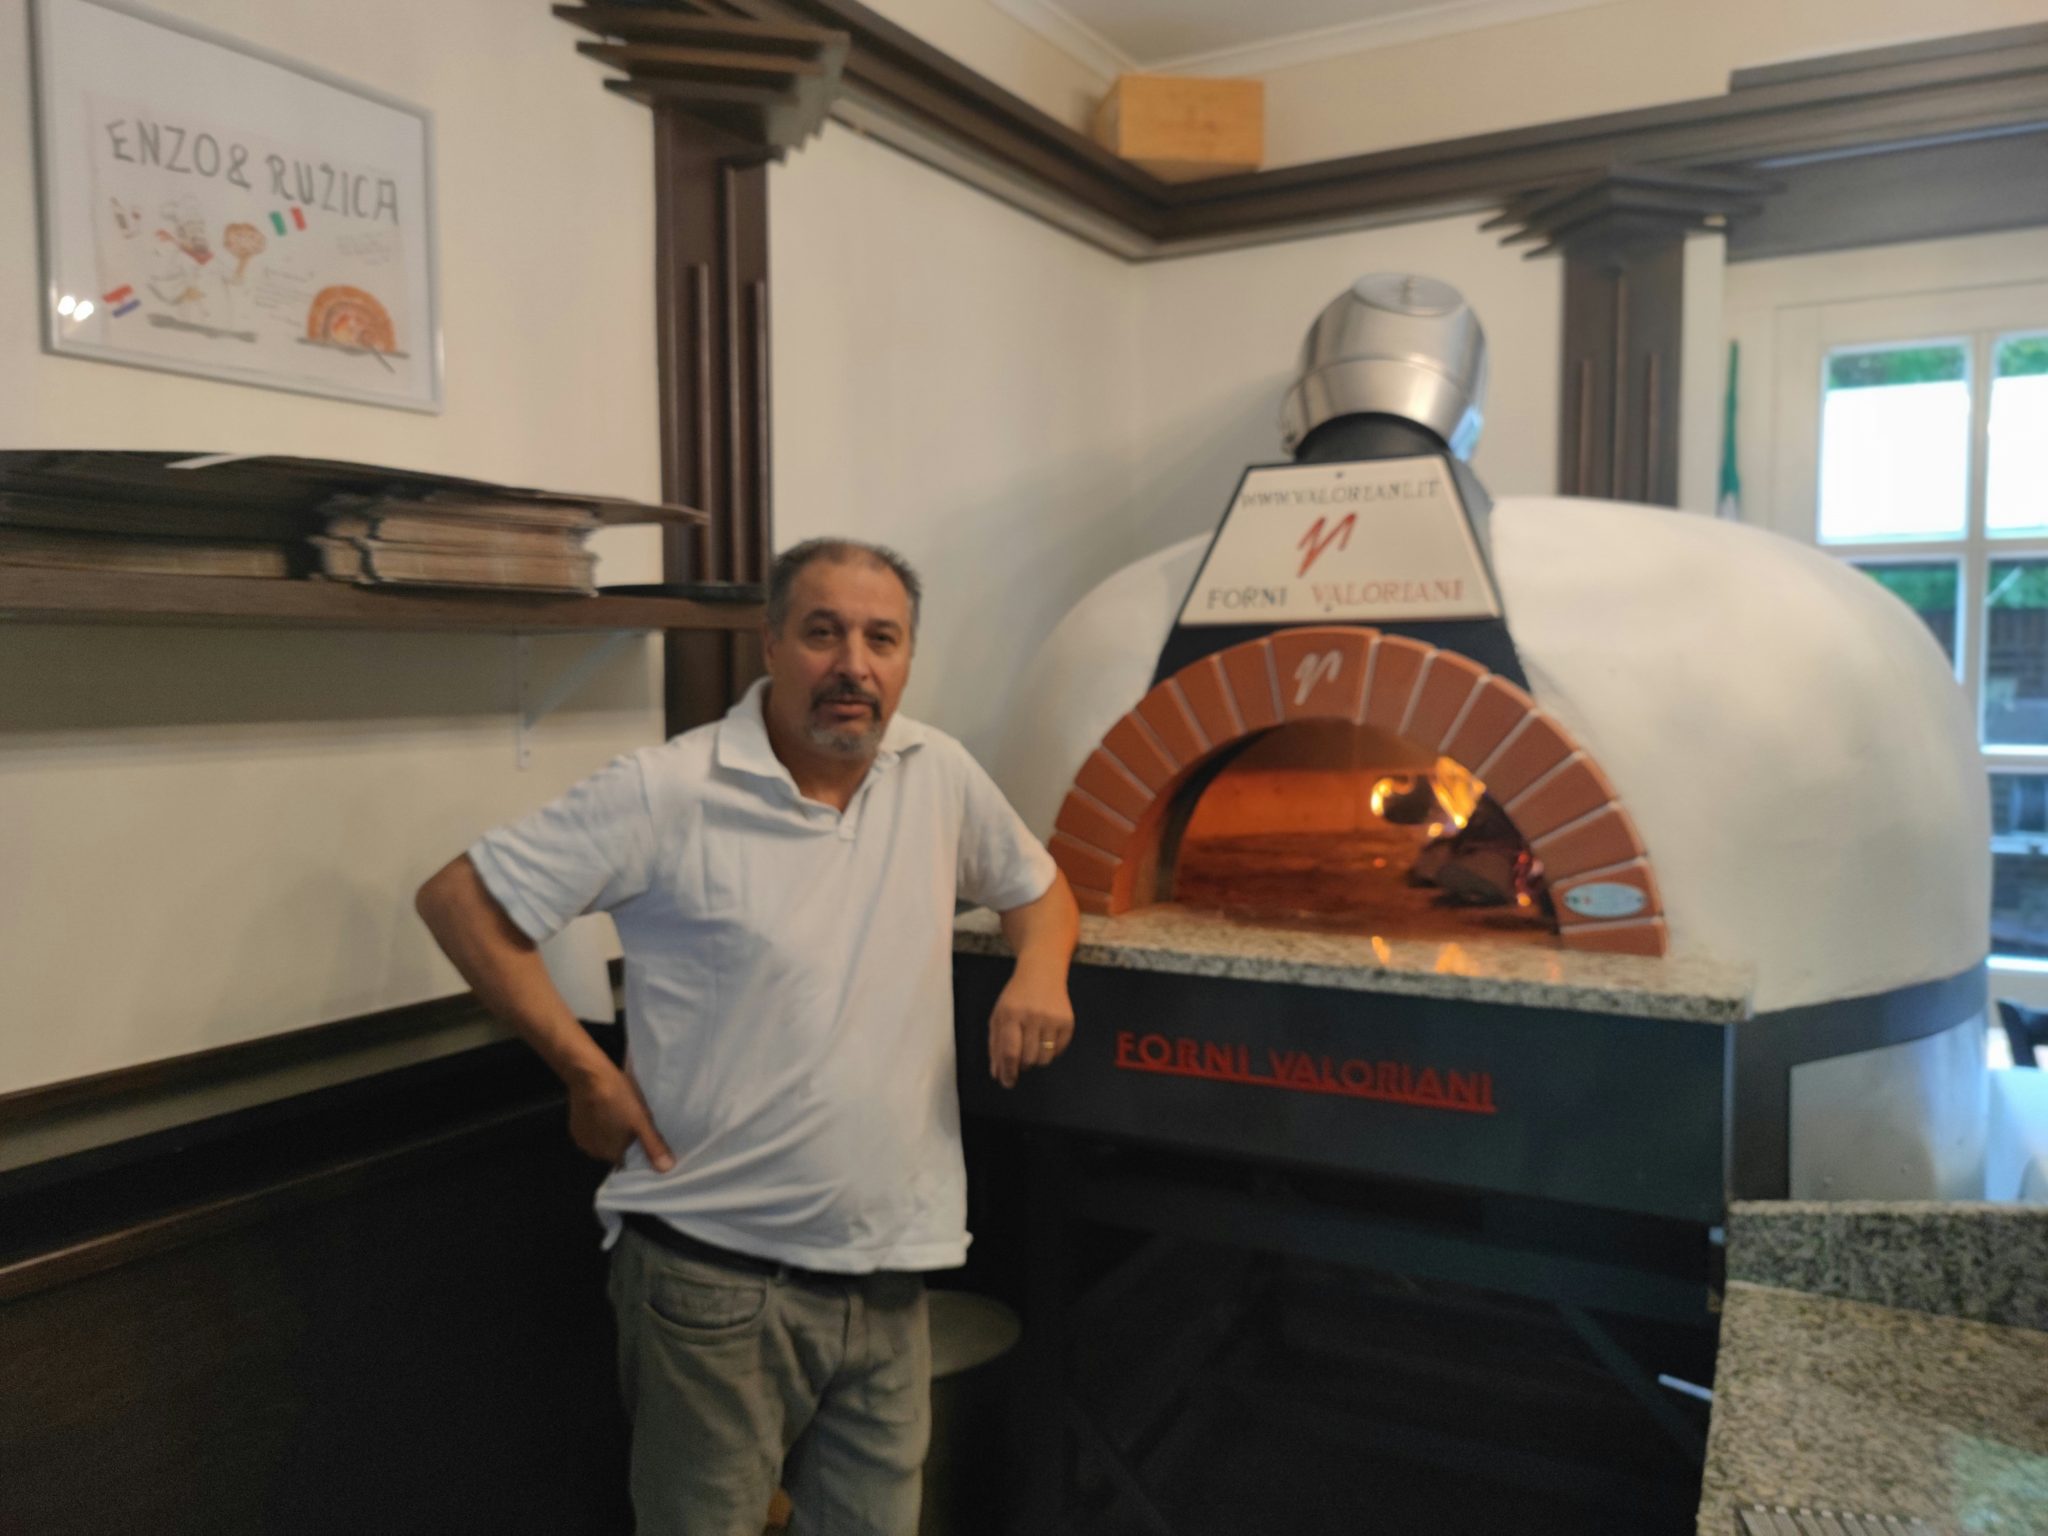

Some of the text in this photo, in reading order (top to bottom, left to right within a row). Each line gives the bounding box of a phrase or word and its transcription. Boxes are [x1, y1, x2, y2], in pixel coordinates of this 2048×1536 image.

[265, 153, 399, 226] RUZICA
[1208, 579, 1464, 611] FORNI VALORIANI
[1116, 1031, 1495, 1110] FORNI VALORIANI
